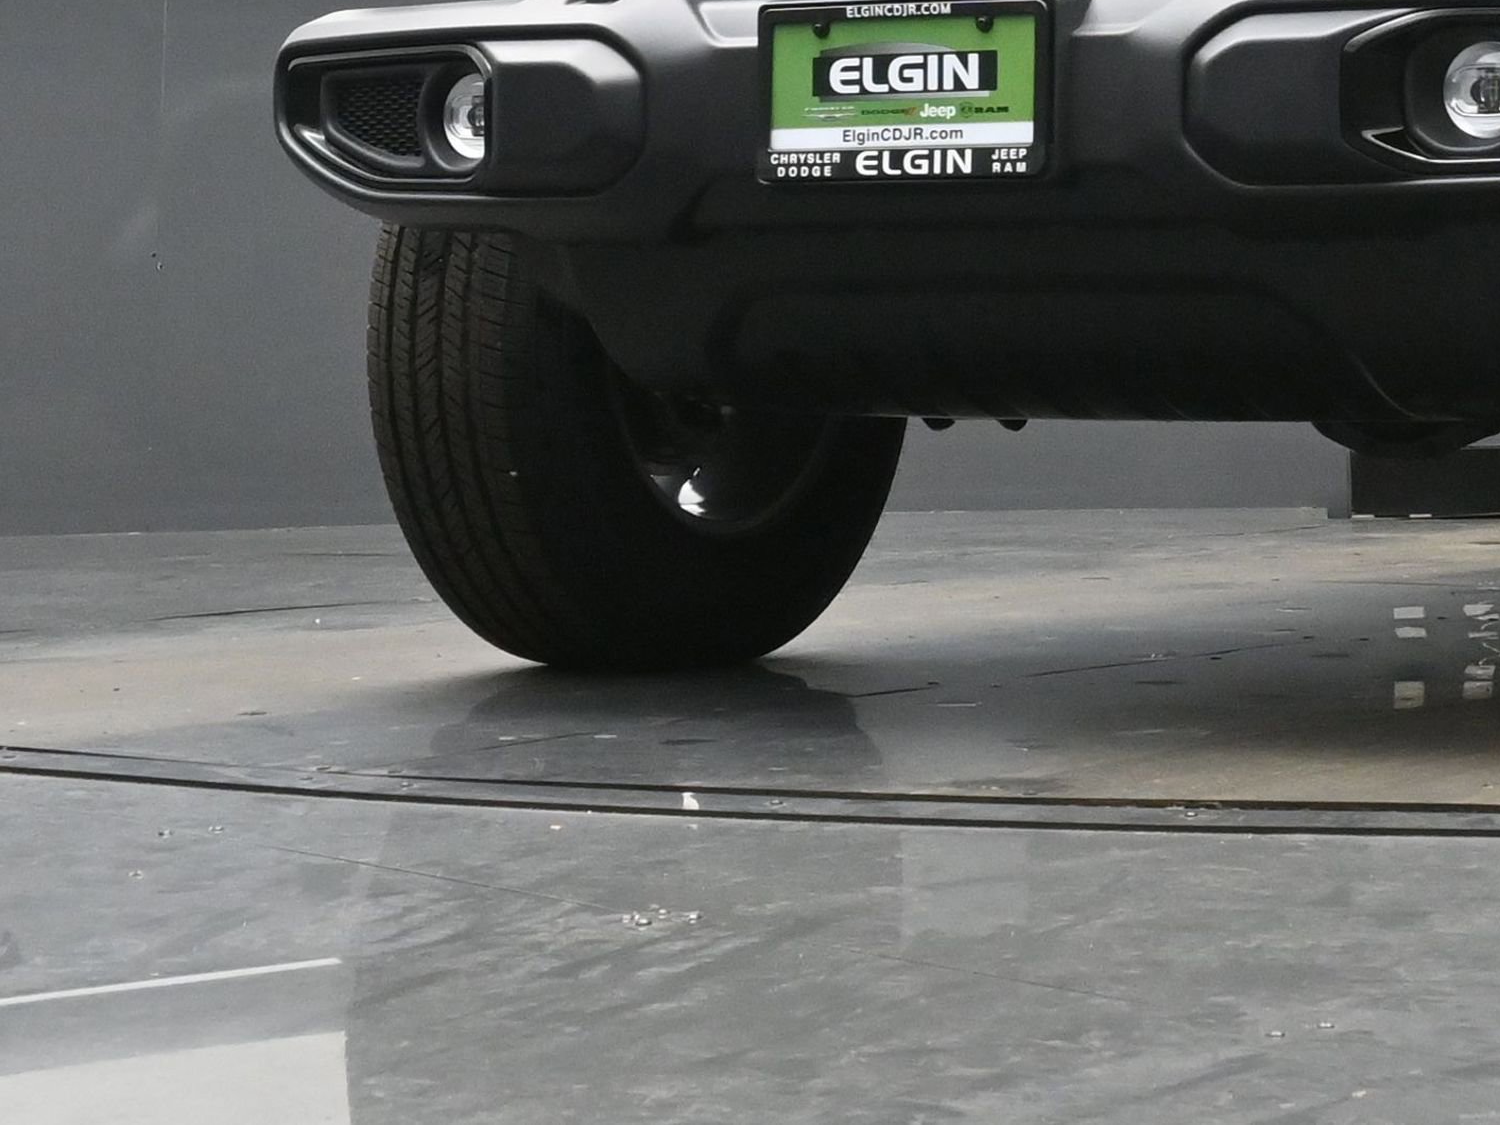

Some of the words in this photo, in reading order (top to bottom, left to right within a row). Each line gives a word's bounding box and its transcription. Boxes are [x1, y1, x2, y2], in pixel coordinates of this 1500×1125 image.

[846, 3, 952, 18] ELGINCDJR.COM
[828, 53, 980, 94] ELGIN
[920, 103, 956, 119] Jeep
[974, 105, 1009, 114] RAM
[842, 127, 964, 146] ElginCDJR.com
[770, 152, 841, 165] CHRYSLER
[991, 148, 1027, 160] JEEP
[855, 148, 972, 176] ELGIN
[993, 161, 1027, 173] RAM
[777, 165, 832, 178] DODGE
